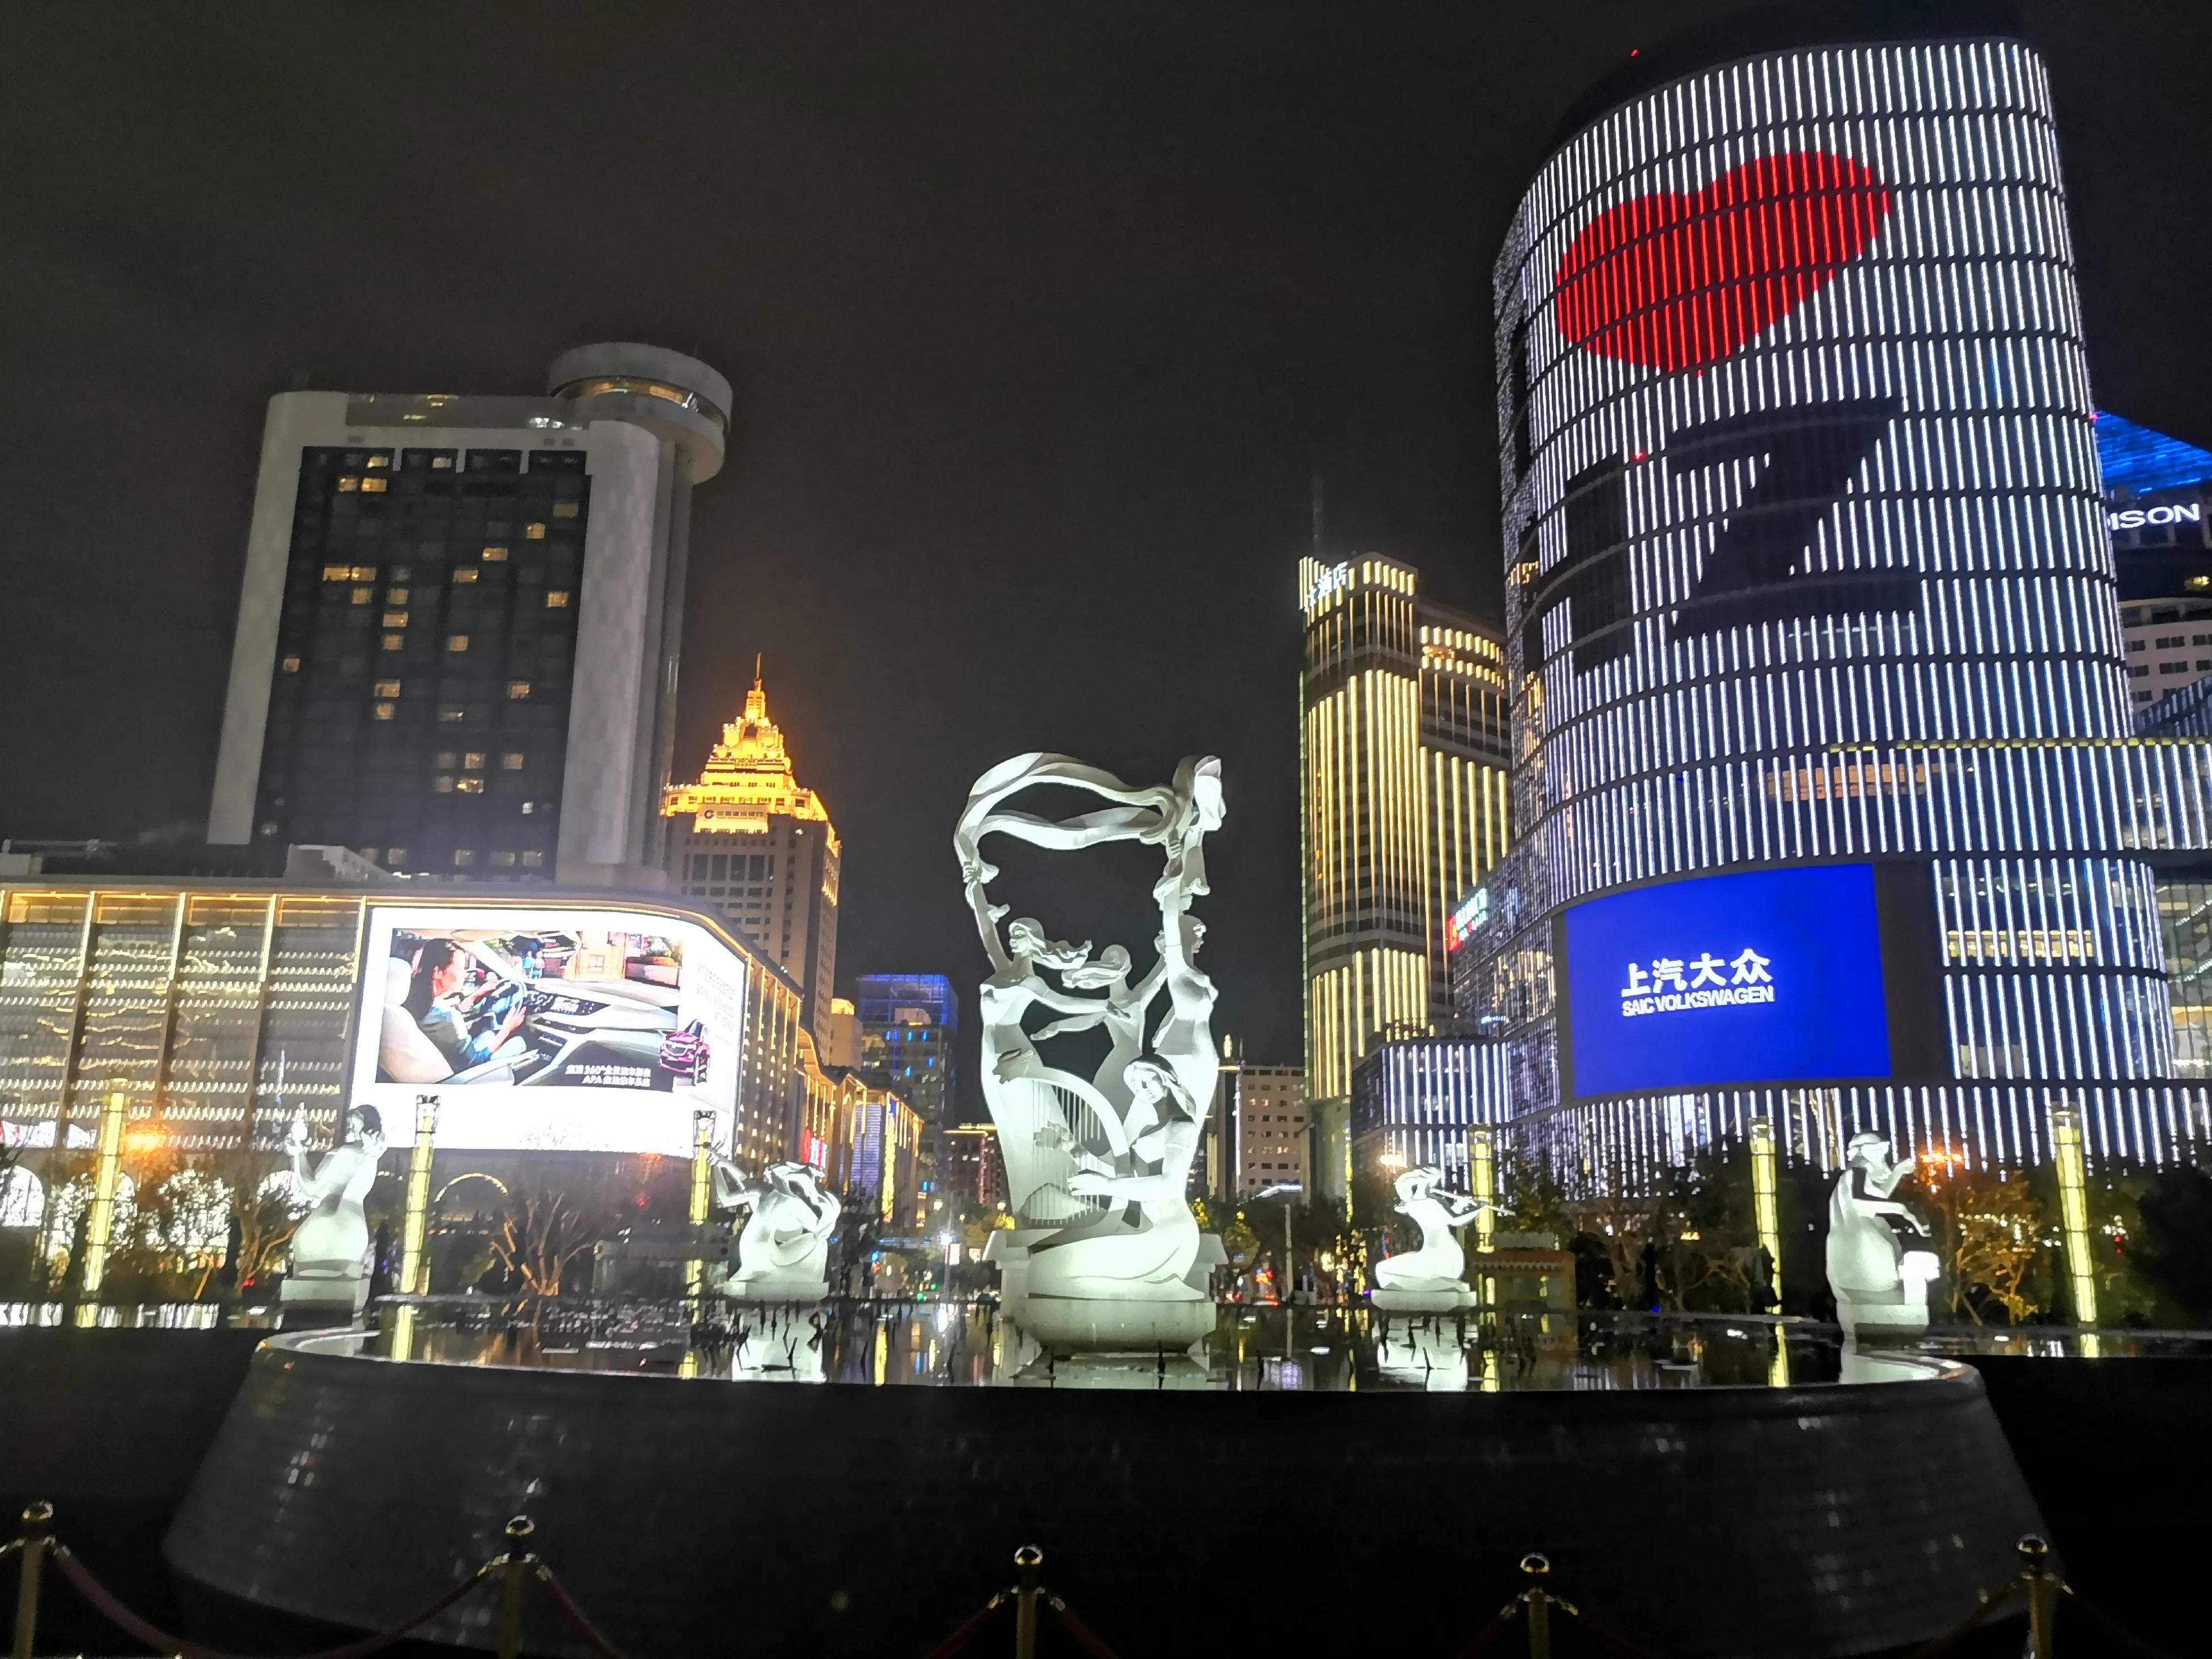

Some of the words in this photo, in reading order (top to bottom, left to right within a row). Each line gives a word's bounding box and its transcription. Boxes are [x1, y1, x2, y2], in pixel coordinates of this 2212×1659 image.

[2107, 503, 2200, 530] ISON
[1621, 948, 1773, 997] 上汽大众
[1623, 997, 1655, 1017] SAIC
[1654, 985, 1775, 1012] VOLKSWAGEN
